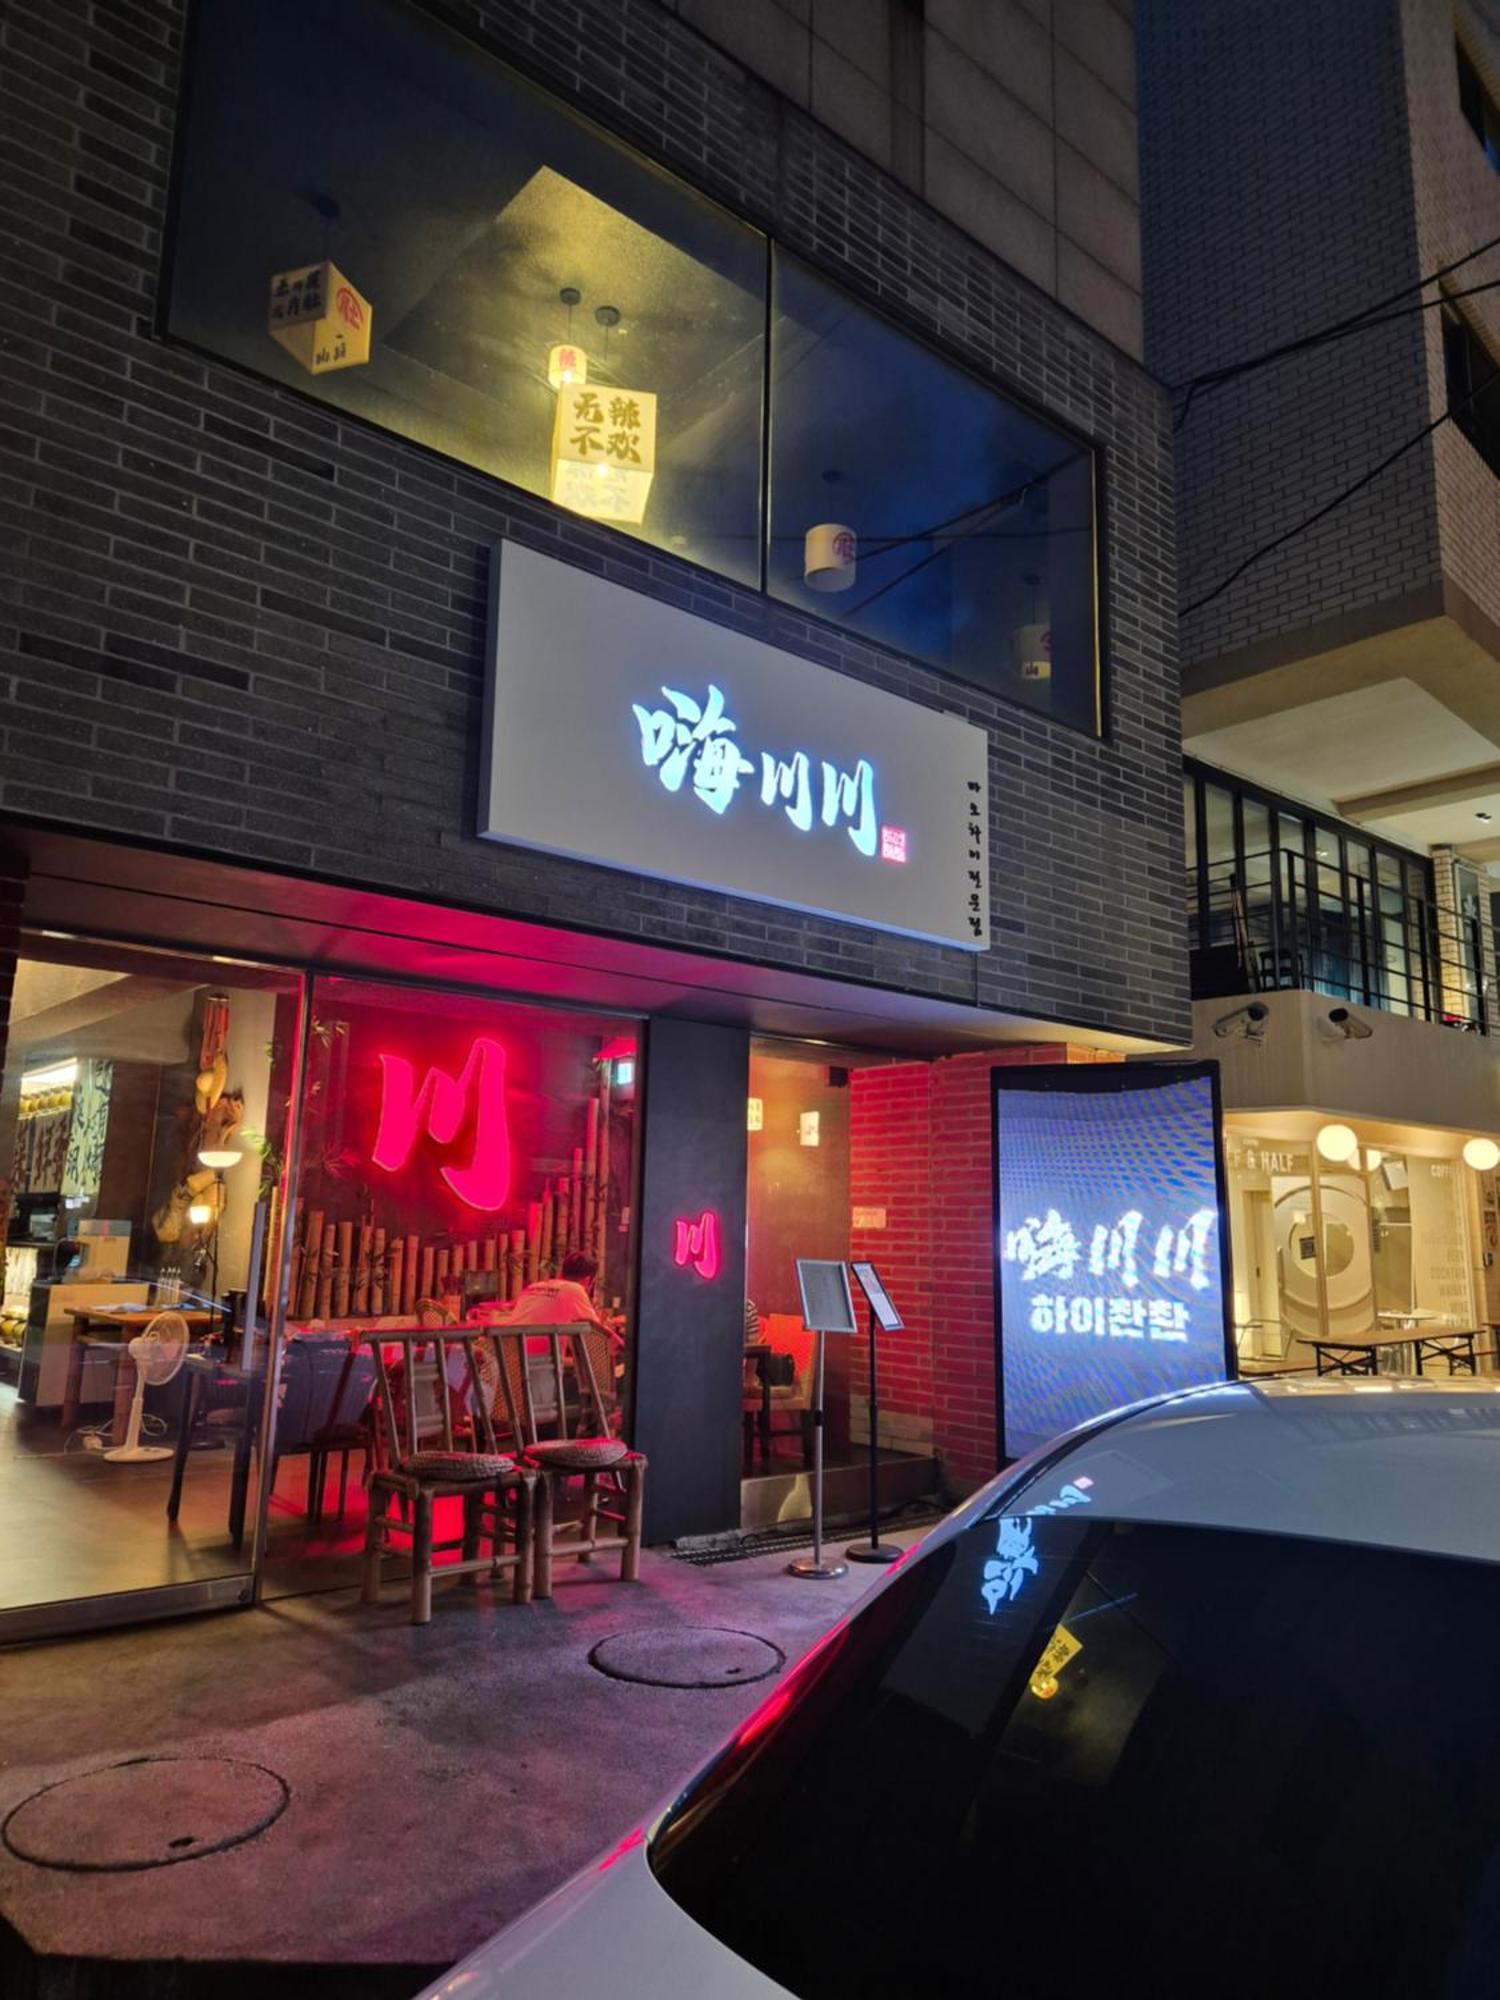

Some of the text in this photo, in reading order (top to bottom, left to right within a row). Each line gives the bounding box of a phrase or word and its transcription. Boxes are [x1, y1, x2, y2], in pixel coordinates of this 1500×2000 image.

[632, 684, 877, 857] 嗨川川
[372, 1037, 512, 1211] 川
[1260, 1151, 1294, 1174] HALF
[674, 1211, 720, 1280] 川
[1030, 1293, 1191, 1343] 하이촨촨
